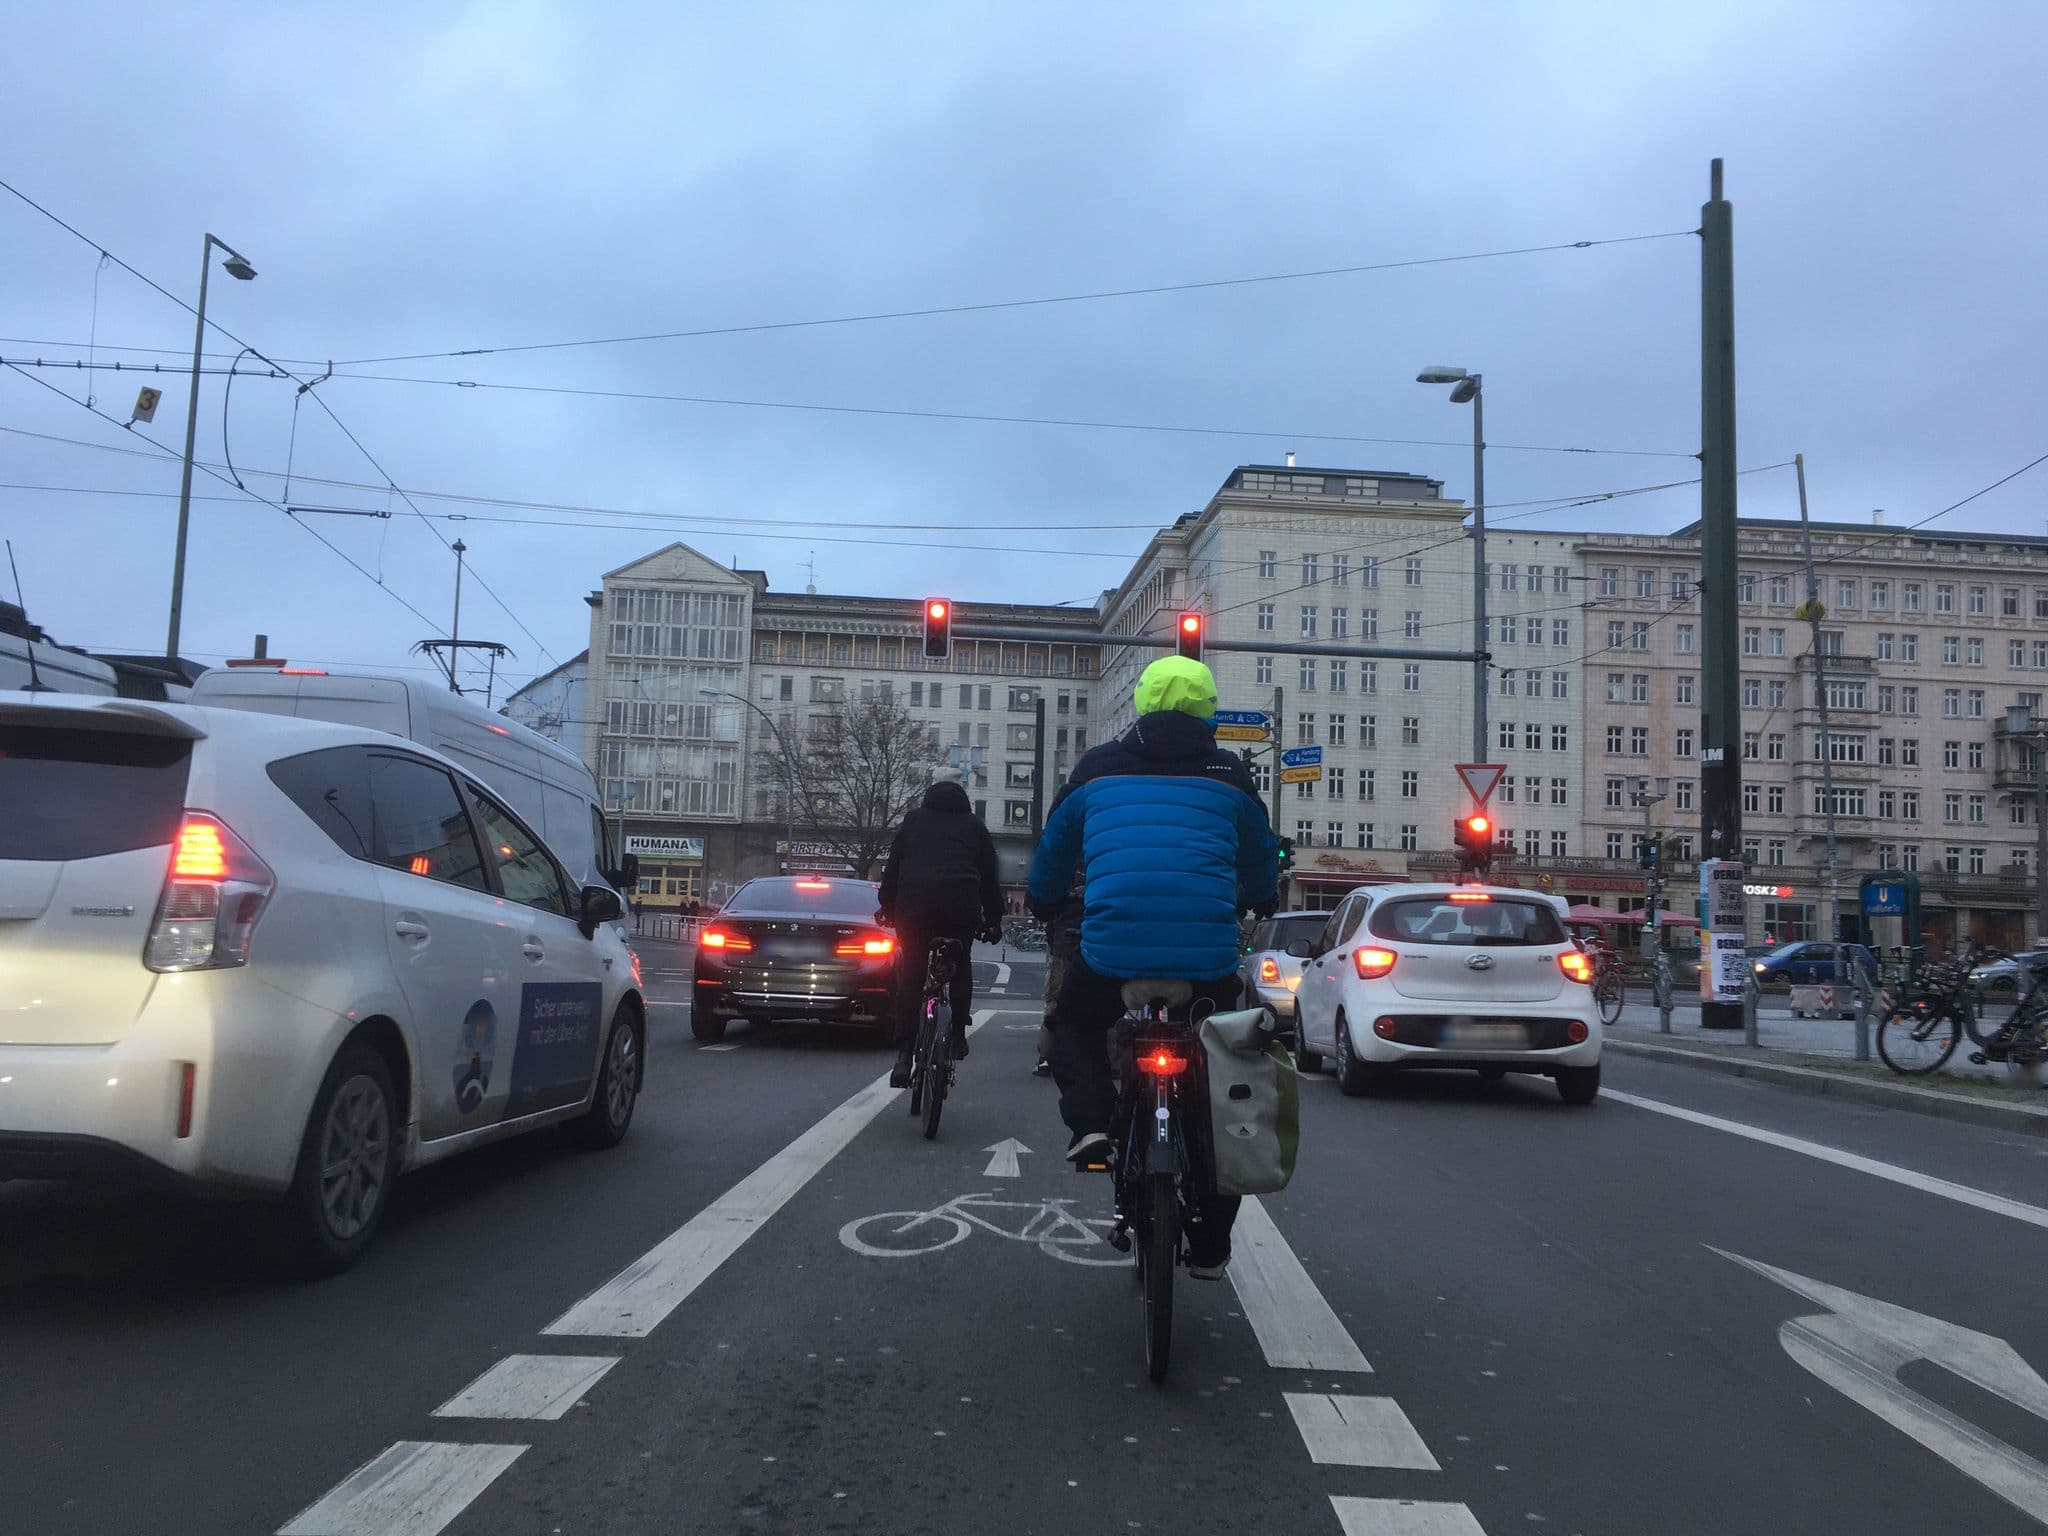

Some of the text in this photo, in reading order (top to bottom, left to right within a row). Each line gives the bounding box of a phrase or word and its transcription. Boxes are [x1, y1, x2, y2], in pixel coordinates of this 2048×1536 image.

[140, 390, 156, 411] 3
[631, 838, 689, 850] HUMANA
[791, 842, 818, 855] FIRST
[1743, 885, 1770, 896] IOSK
[1879, 887, 1888, 903] U
